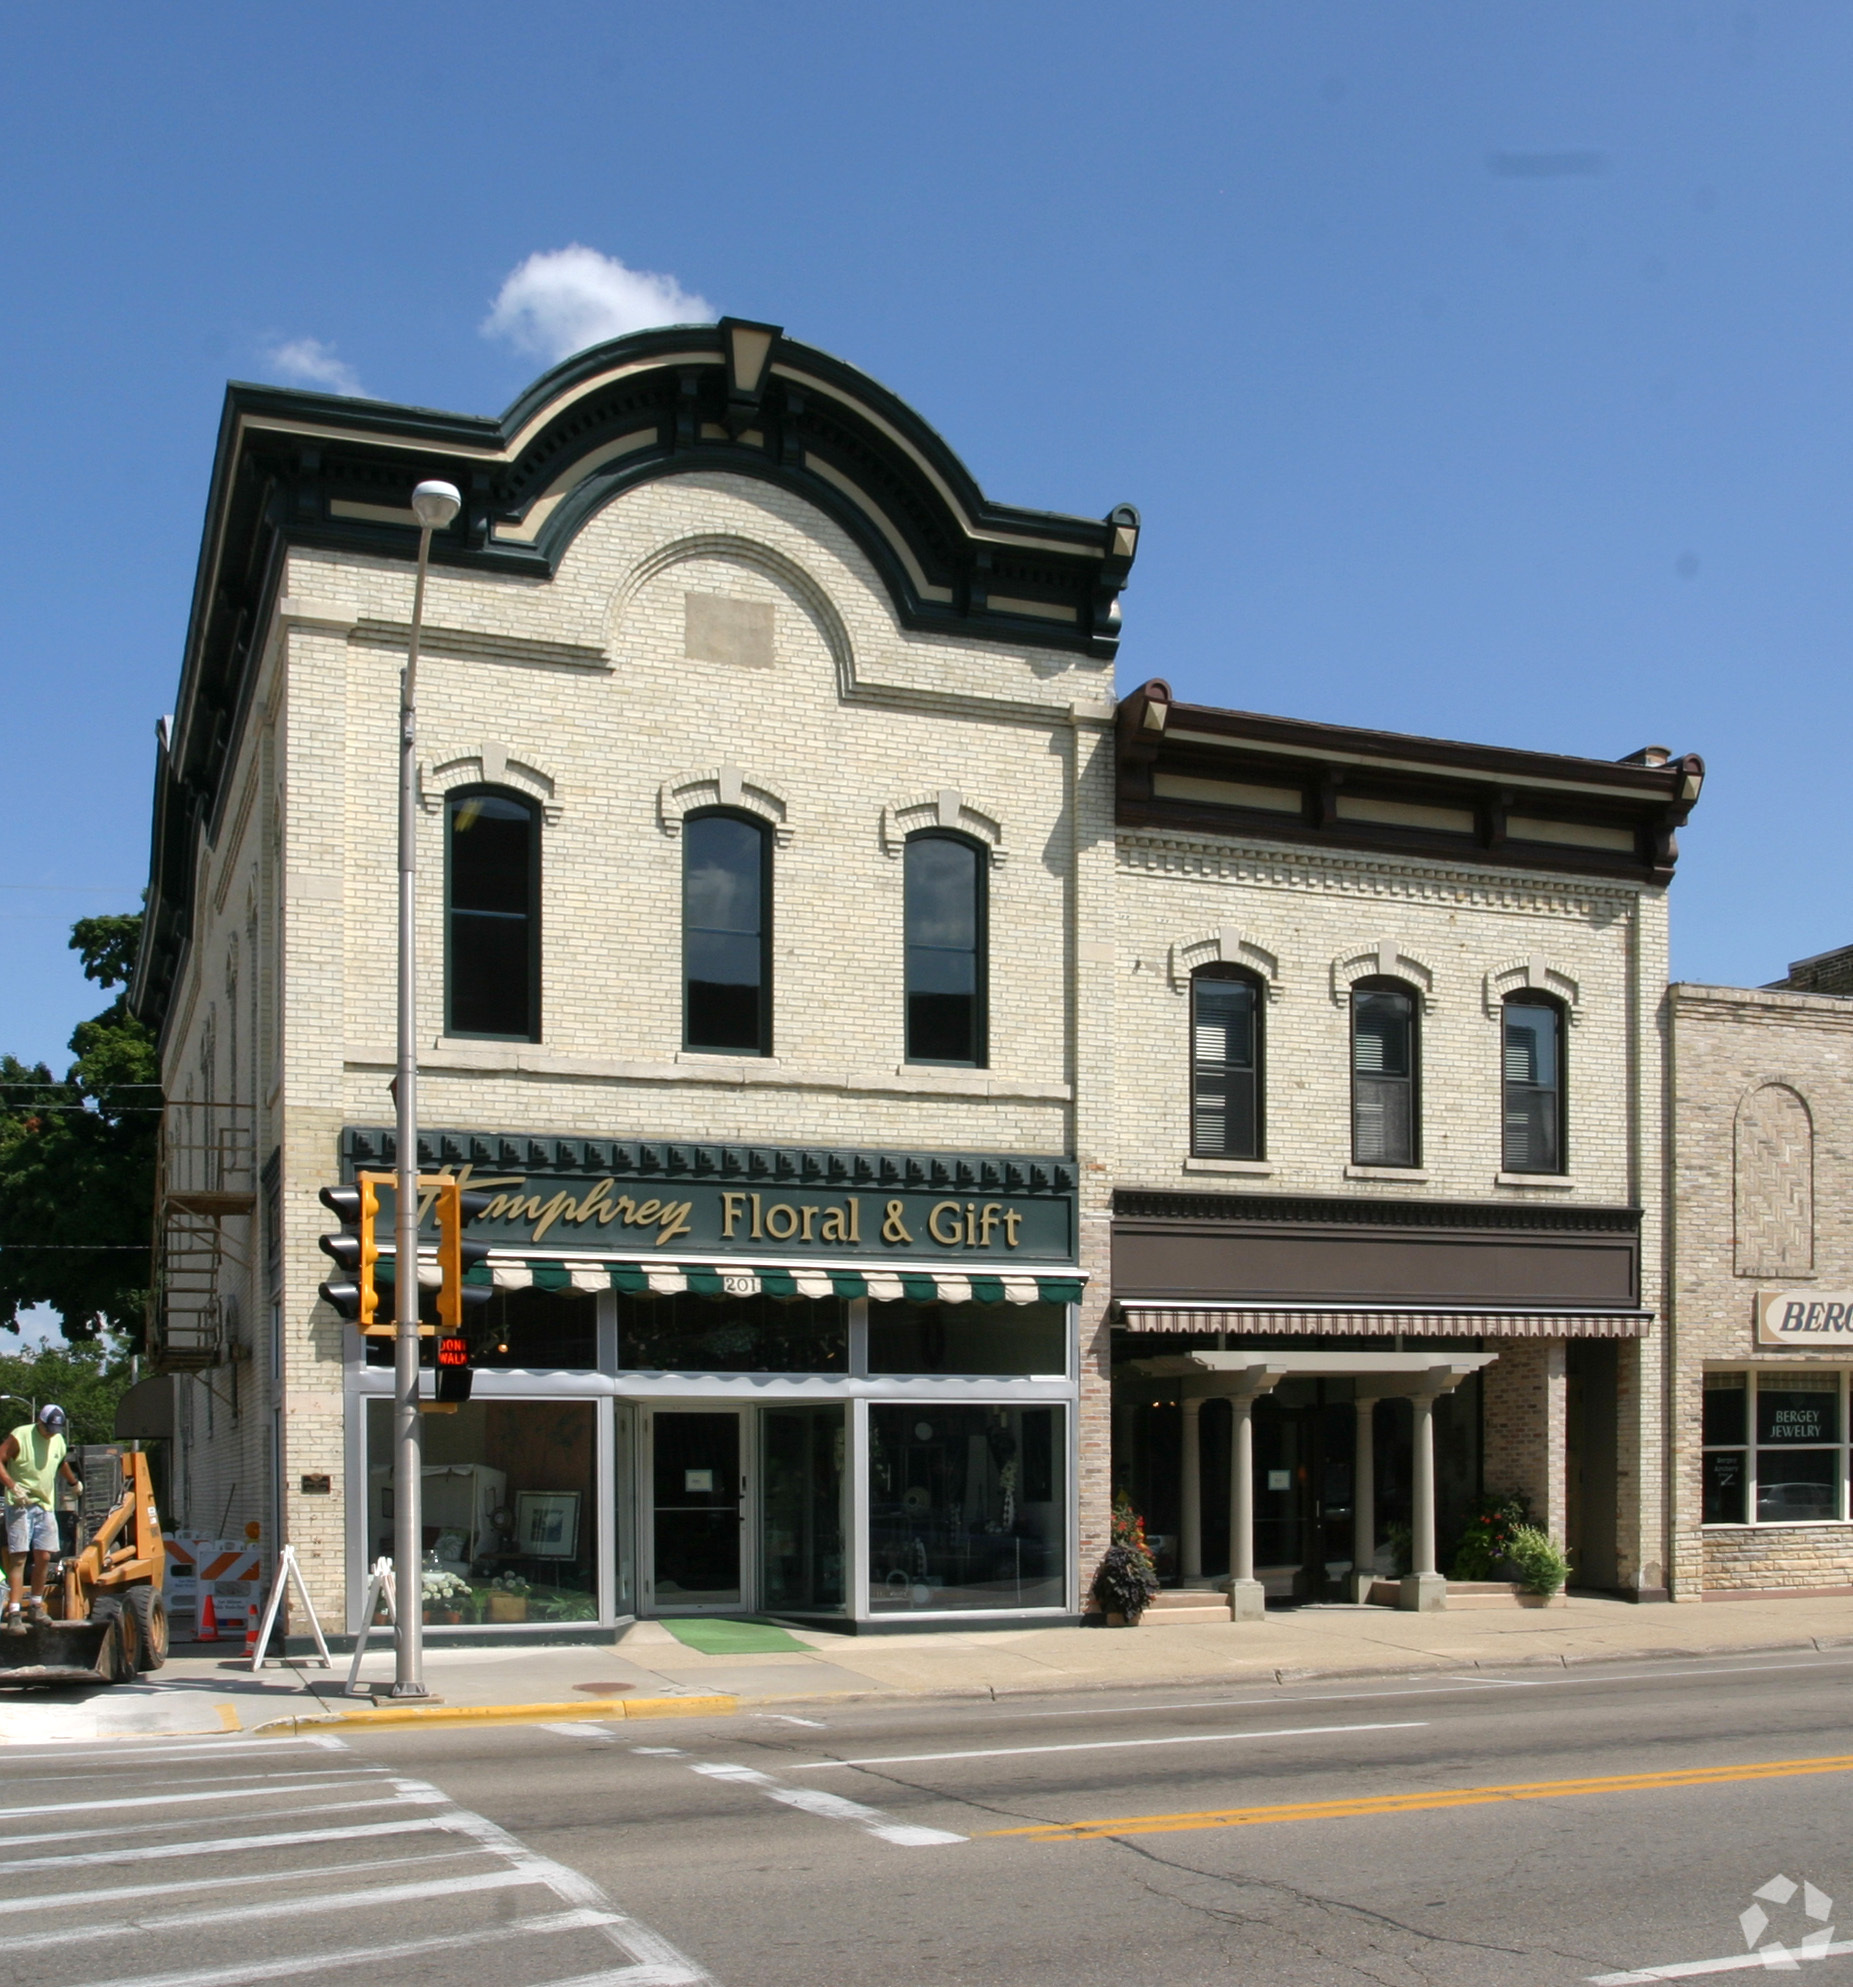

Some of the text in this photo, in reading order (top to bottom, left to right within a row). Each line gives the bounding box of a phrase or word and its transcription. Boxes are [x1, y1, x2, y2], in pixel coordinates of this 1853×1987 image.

[416, 1164, 1022, 1246] Hmphrey Floral & Gift
[725, 1278, 758, 1293] 201
[438, 1352, 467, 1365] WALK
[1776, 1410, 1820, 1423] BERGEY
[1770, 1425, 1821, 1438] JEWELRY
